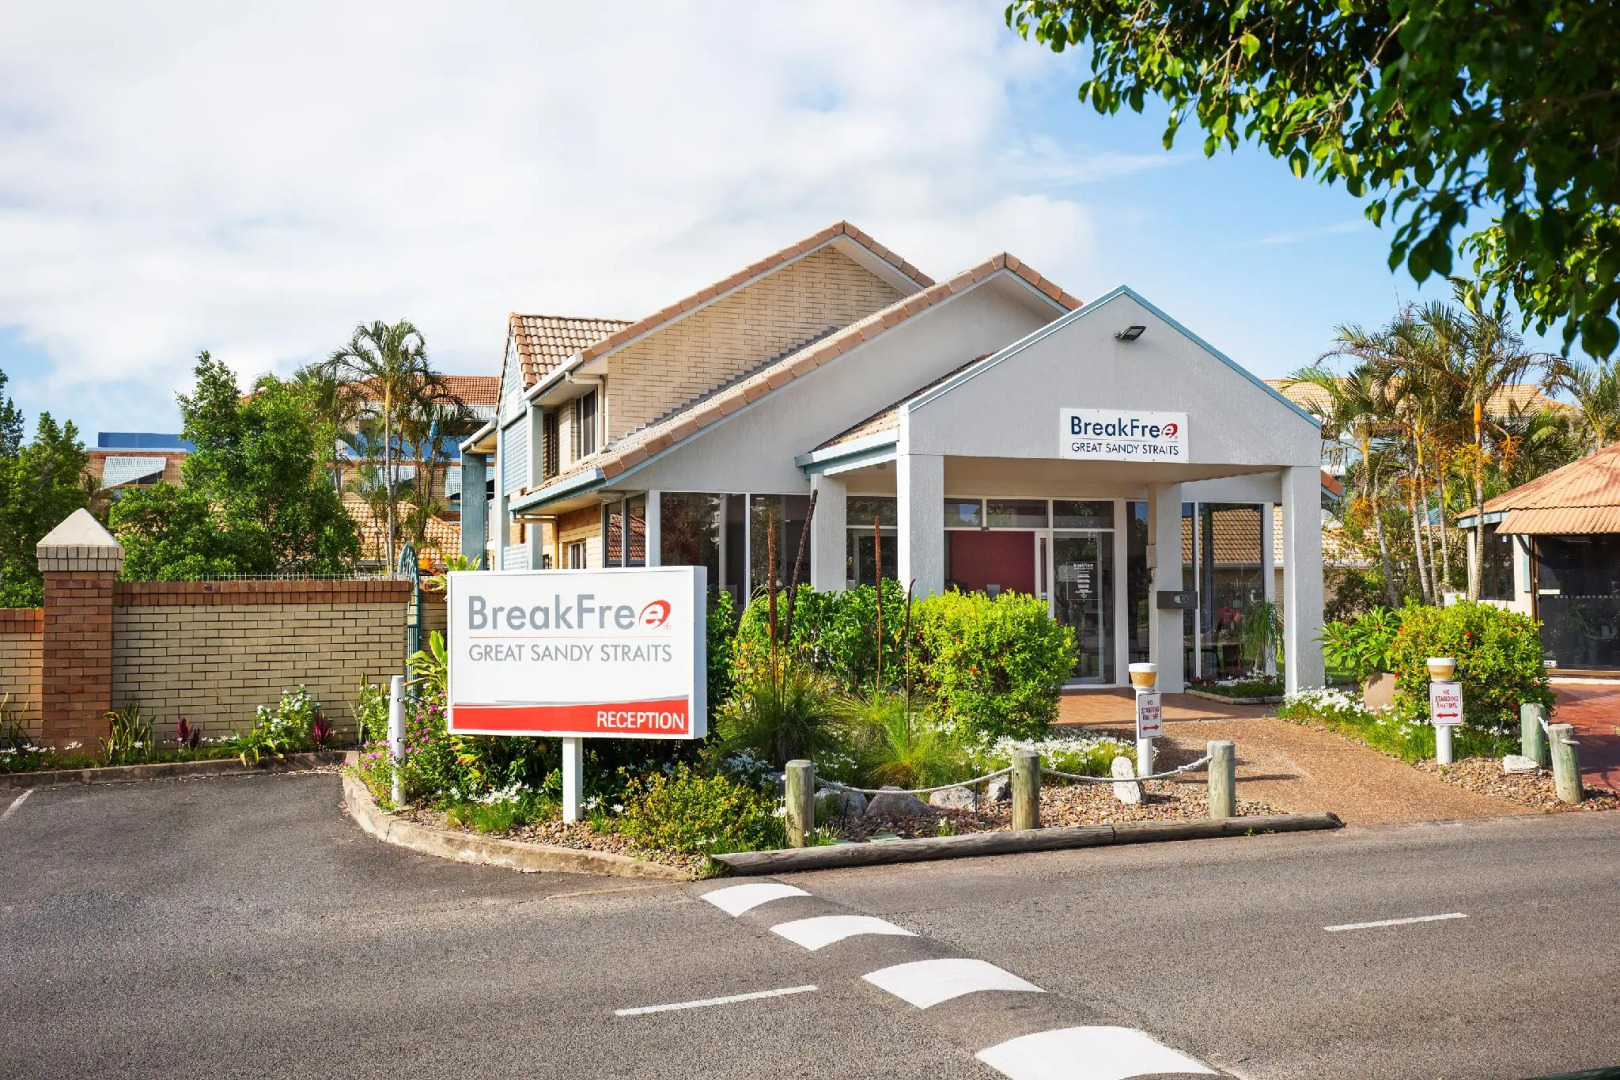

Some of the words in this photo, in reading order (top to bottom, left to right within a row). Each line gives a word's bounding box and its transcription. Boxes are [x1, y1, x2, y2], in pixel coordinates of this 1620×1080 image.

[1071, 416, 1178, 439] BreakFree
[1072, 442, 1102, 453] GREAT
[1106, 443, 1139, 454] SANDY
[1142, 444, 1179, 456] STRAITS
[469, 594, 671, 630] BreakFree
[469, 644, 525, 662] GREAT
[531, 644, 594, 662] SANDY
[600, 644, 672, 662] STRAITS
[597, 711, 684, 730] RECEPTION
